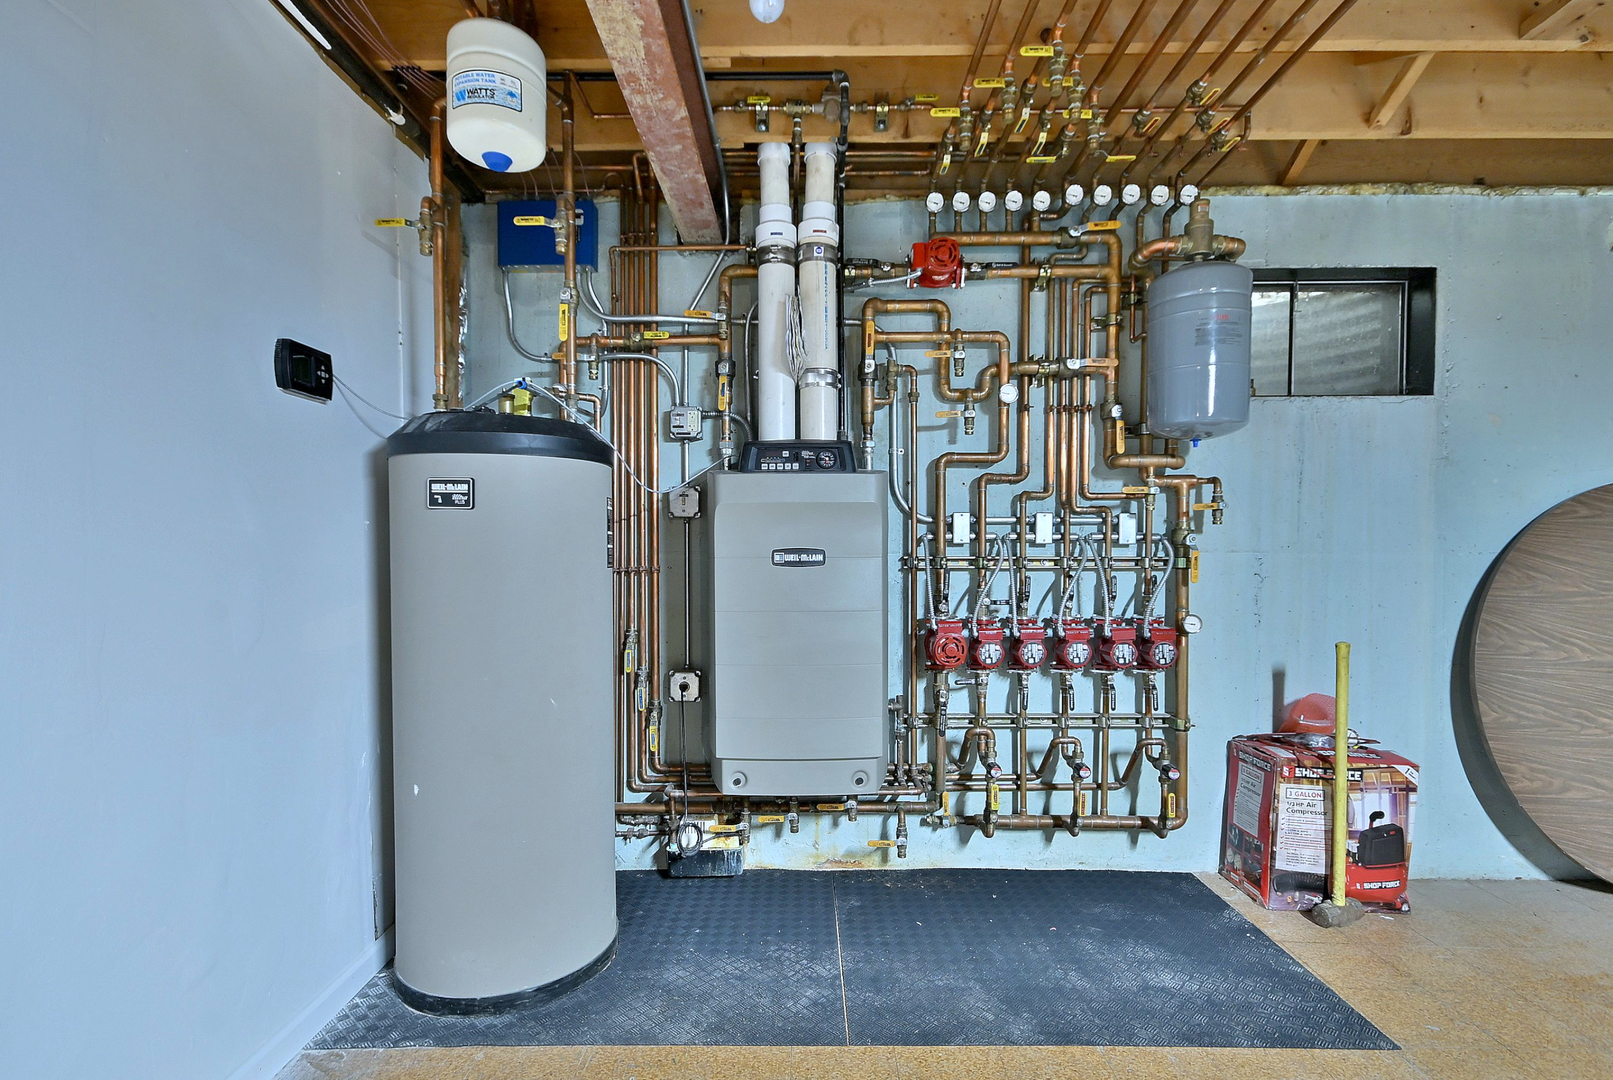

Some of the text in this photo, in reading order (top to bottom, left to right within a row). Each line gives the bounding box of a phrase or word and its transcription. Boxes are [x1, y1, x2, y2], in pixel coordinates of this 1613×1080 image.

[466, 87, 496, 96] WATTS
[1294, 791, 1323, 799] GALLON
[1306, 801, 1318, 809] Air
[1285, 806, 1329, 816] Compressor
